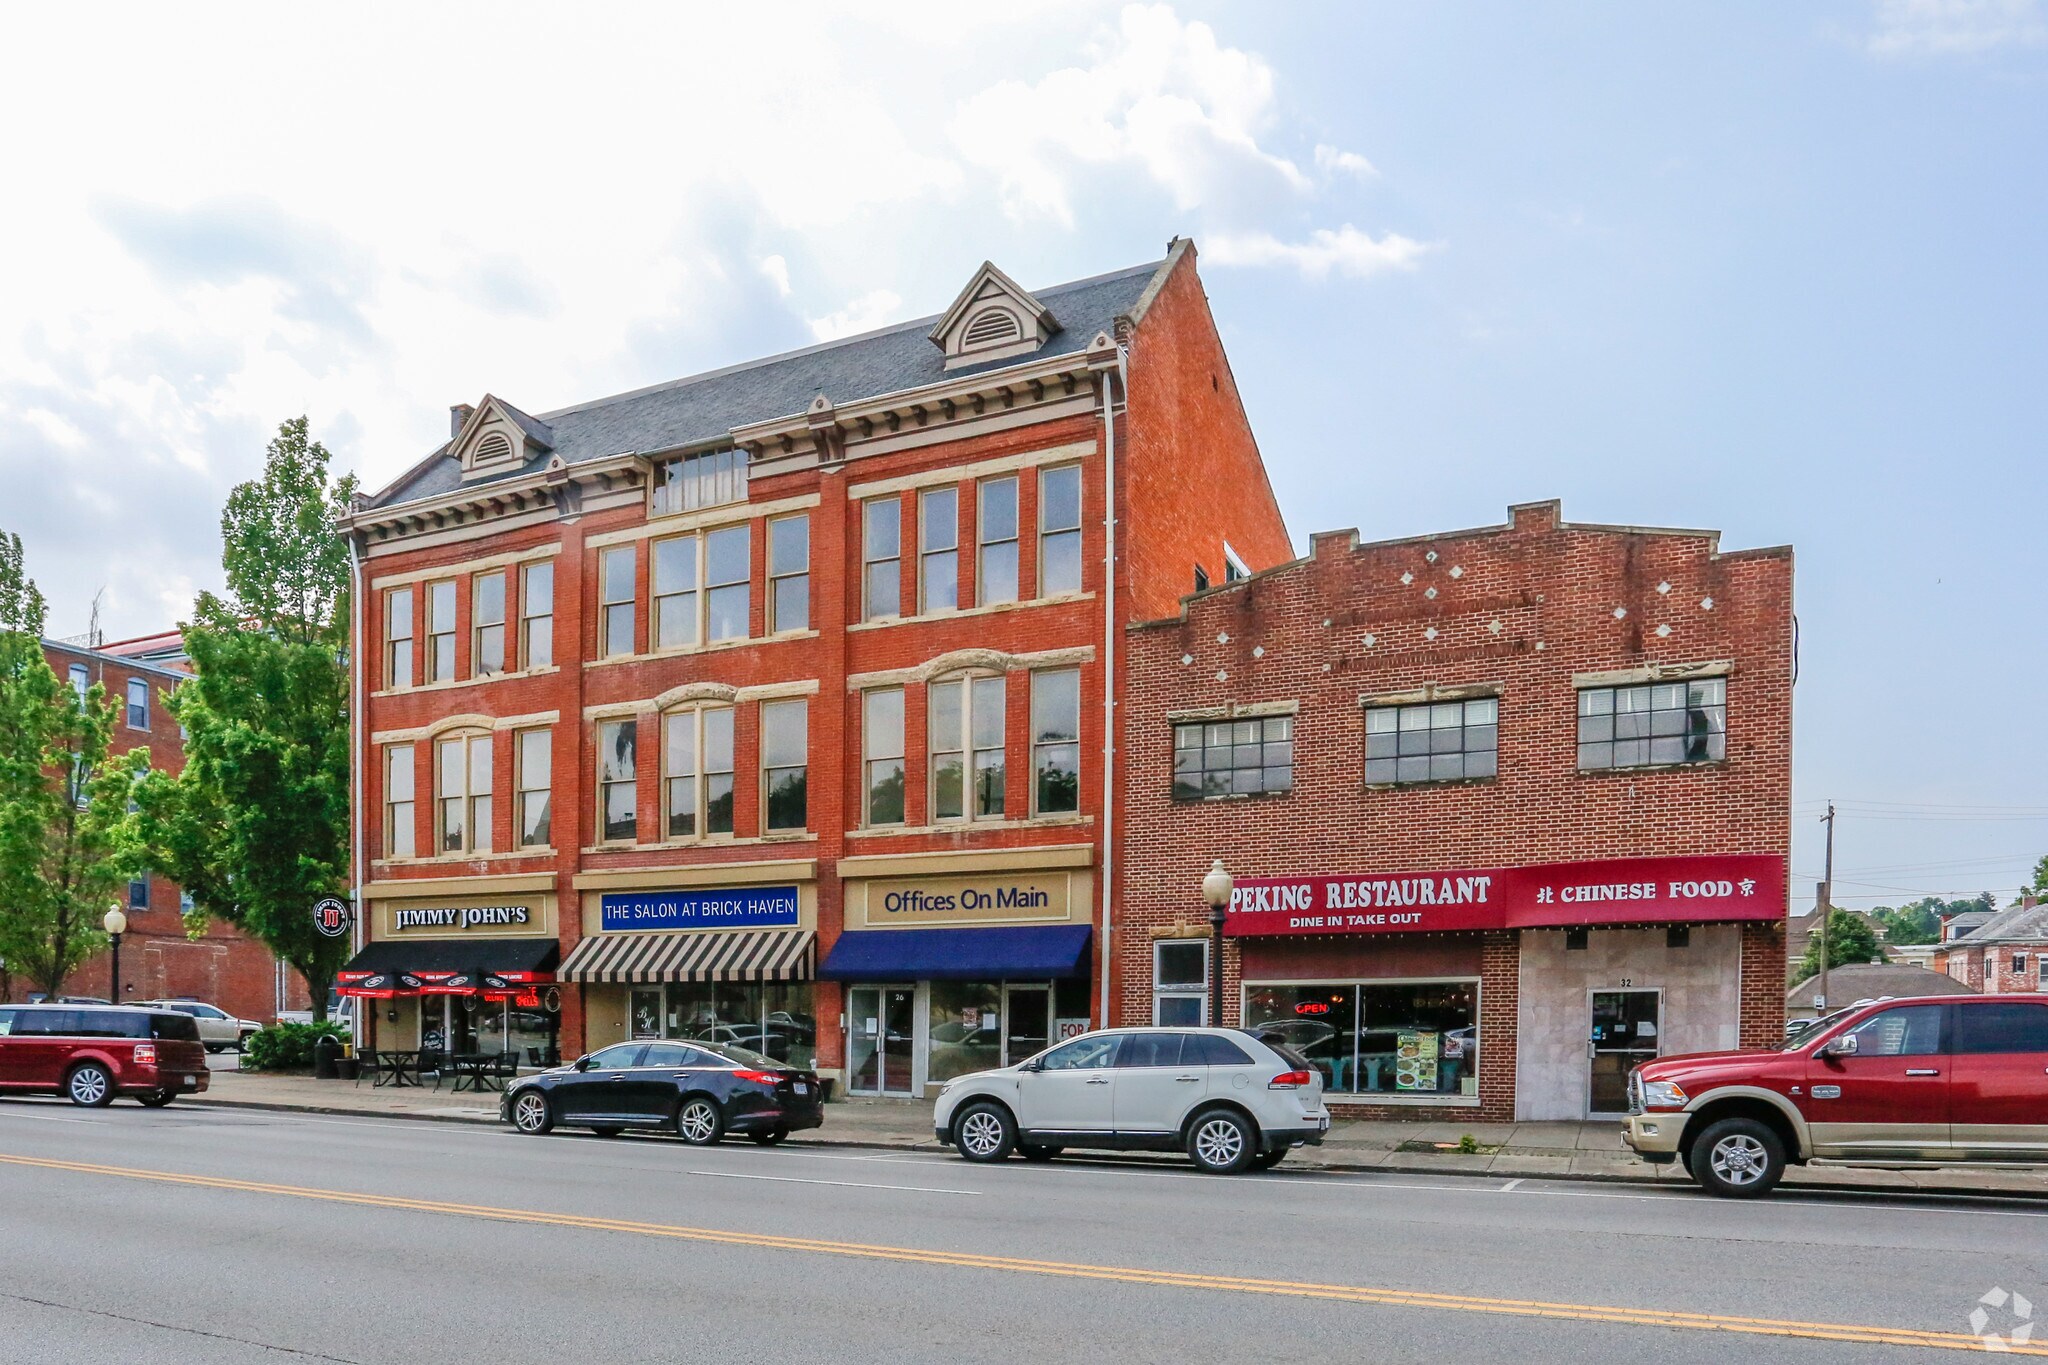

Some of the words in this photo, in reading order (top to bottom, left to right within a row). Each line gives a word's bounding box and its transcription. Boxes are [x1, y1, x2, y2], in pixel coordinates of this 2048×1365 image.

[1228, 884, 1312, 913] PEKING
[1326, 876, 1491, 908] RESTAURANT
[1537, 886, 1554, 904] 北
[1560, 882, 1656, 903] CHINESE
[1669, 880, 1733, 899] FOOD
[1737, 878, 1756, 897] 京
[605, 905, 630, 919] THE
[634, 903, 677, 918] SALON
[682, 902, 697, 917] AT
[702, 901, 742, 916] BRICK
[748, 898, 794, 914] HAVEN
[885, 890, 956, 912] Offices
[961, 889, 991, 910] On
[996, 886, 1048, 909] Main
[324, 908, 339, 927] JJ
[396, 908, 456, 930] JIMMY
[461, 907, 527, 928] JOHN'S
[1290, 917, 1323, 928] DINE
[1327, 916, 1342, 926] IN
[1346, 914, 1386, 926] TAKE
[1389, 913, 1422, 924] OUT
[1621, 979, 1631, 987] 32
[1296, 1003, 1328, 1014] OPEN
[1061, 1023, 1084, 1037] FOR
